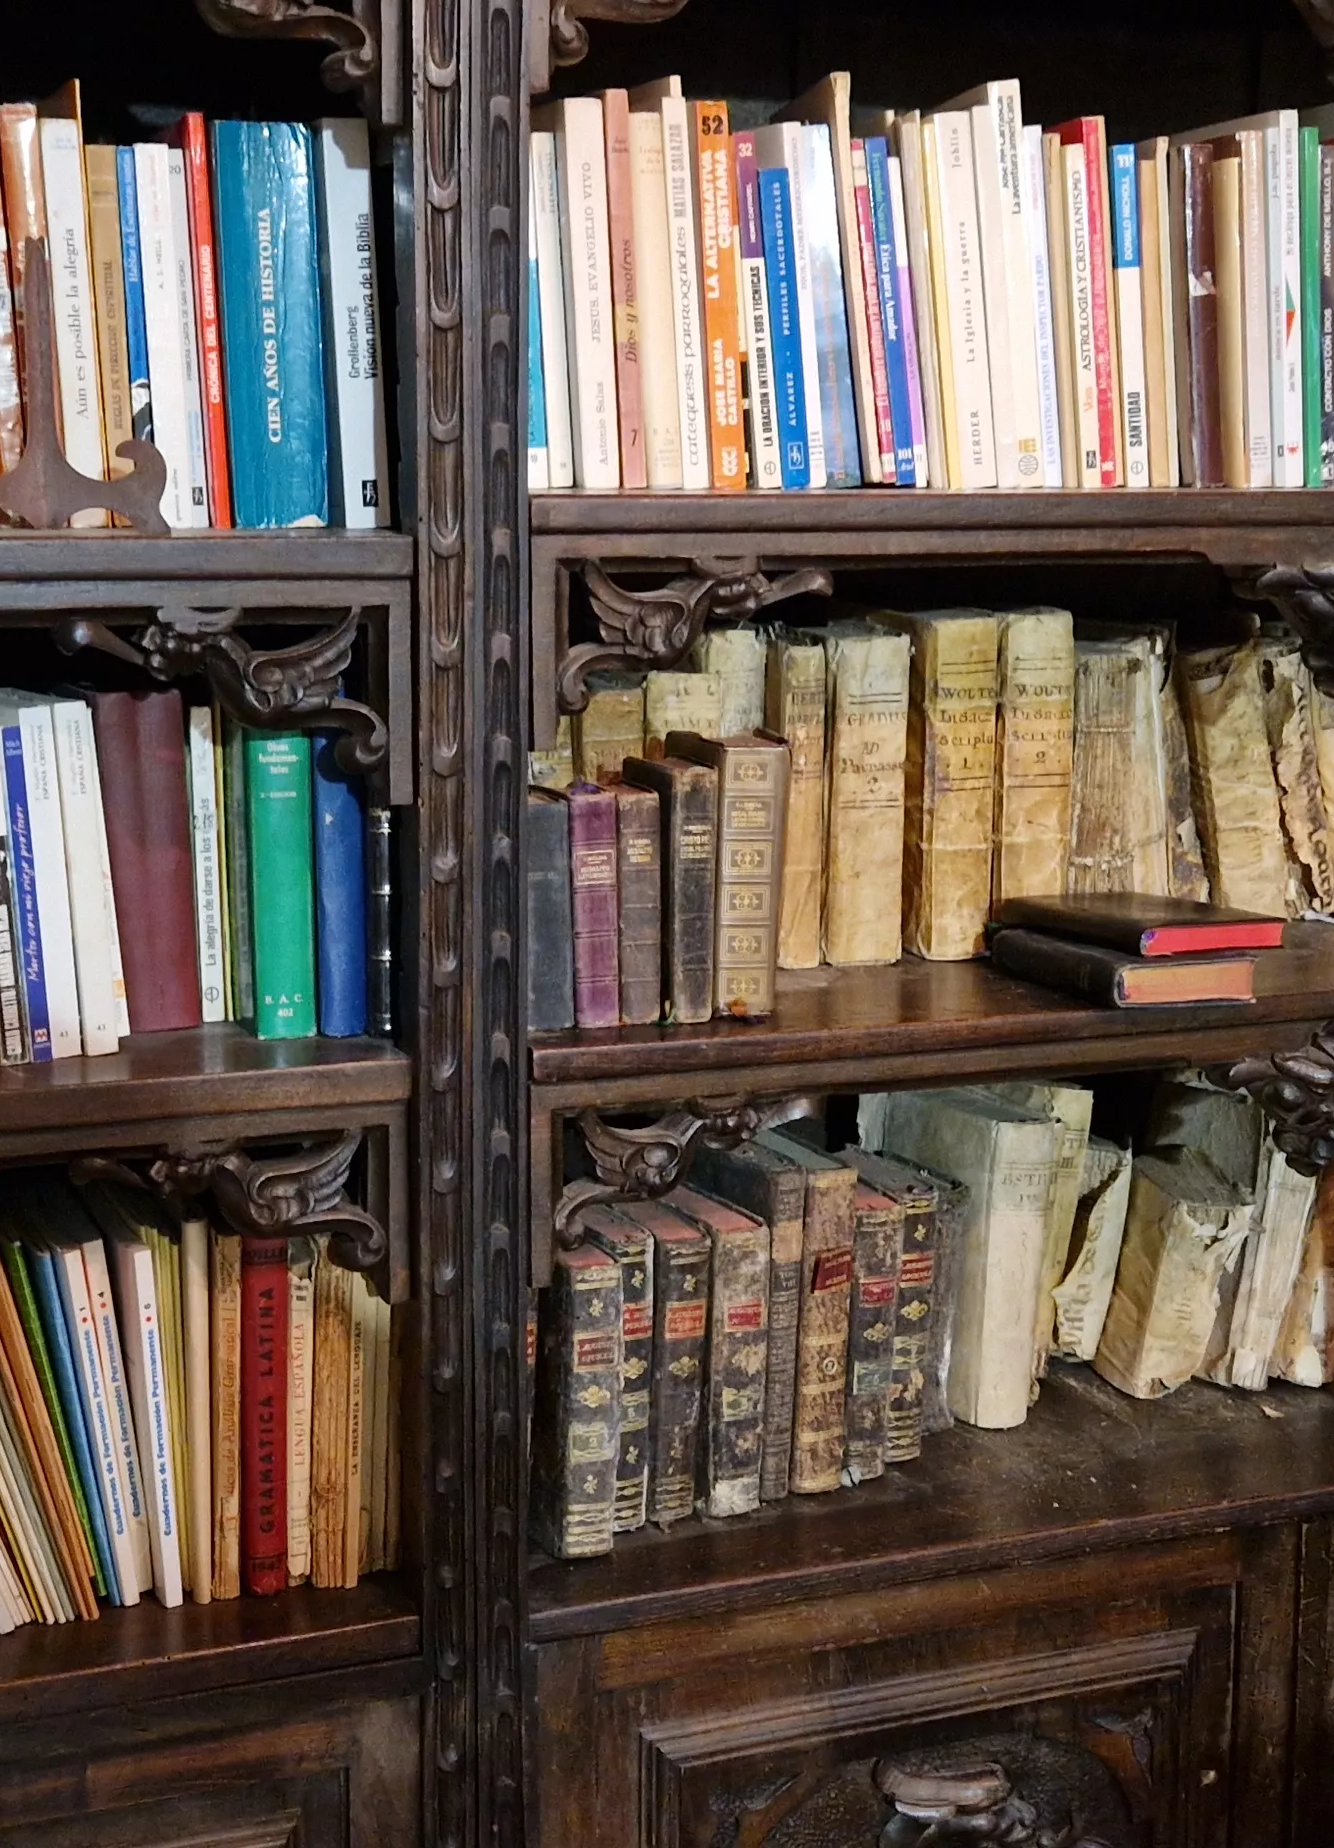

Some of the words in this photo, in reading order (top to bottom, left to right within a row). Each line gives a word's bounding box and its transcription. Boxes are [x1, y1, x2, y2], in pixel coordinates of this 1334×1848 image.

[702, 115, 723, 136] 52
[739, 142, 753, 157] 32
[950, 128, 962, 169] Joblin
[698, 150, 718, 270] ALTERNATIVA
[715, 150, 730, 248] CRISTIANA
[1072, 171, 1086, 271] CRISTIANISMO
[355, 214, 371, 252] Biblia
[772, 182, 787, 276] SACERDOTALES
[957, 221, 970, 264] guerra
[61, 228, 79, 278] alegría
[256, 208, 276, 302] HISTORIA
[359, 257, 371, 269] la
[620, 239, 634, 308] nosotros
[66, 282, 79, 298] la
[199, 245, 217, 319] CENTENARIO
[361, 273, 373, 291] de
[706, 275, 719, 298] LA
[749, 266, 763, 312] TECNICAS
[960, 269, 970, 282] la
[1077, 275, 1086, 283] Y
[262, 308, 276, 334] DE
[363, 294, 376, 335] nueva
[625, 313, 639, 324] y
[753, 315, 764, 333] SUS
[779, 281, 790, 335] PERFILES
[962, 299, 976, 343] Iglesia
[1077, 287, 1092, 371] ASTROLOGÍA
[1323, 308, 1332, 333] DIOS
[69, 304, 86, 359] posible
[207, 323, 217, 347] DEL
[347, 306, 361, 378] Grollenberg
[623, 329, 638, 364] Dios
[1324, 335, 1332, 357] CON
[74, 367, 85, 381] es
[208, 351, 222, 403] CRÓNICA
[261, 340, 280, 392] AÑOS
[363, 338, 378, 379] Visión
[712, 339, 724, 384] MARIA
[756, 347, 768, 389] INTERIOR
[966, 348, 976, 363] La
[75, 388, 90, 419] Aún
[725, 358, 737, 425] CASTILLO
[784, 372, 796, 426] ÁLVAREZ
[1323, 360, 1333, 412] CONTACTO
[266, 398, 282, 443] CIEN
[758, 392, 772, 433] ORACION
[1128, 392, 1142, 447] SANTIDAD
[762, 436, 773, 447] LA
[970, 410, 982, 465] HERDER
[1035, 752, 1047, 764] 2
[259, 1287, 274, 1378] LATINA
[145, 1329, 161, 1398] Permanente
[291, 1323, 305, 1399] ESPAÑOLA
[152, 1400, 165, 1459] Formación
[294, 1408, 306, 1466] LENGUA
[158, 1462, 167, 1475] de
[257, 1396, 276, 1534] GRAMATICA
[159, 1477, 172, 1536] Cuadernos
